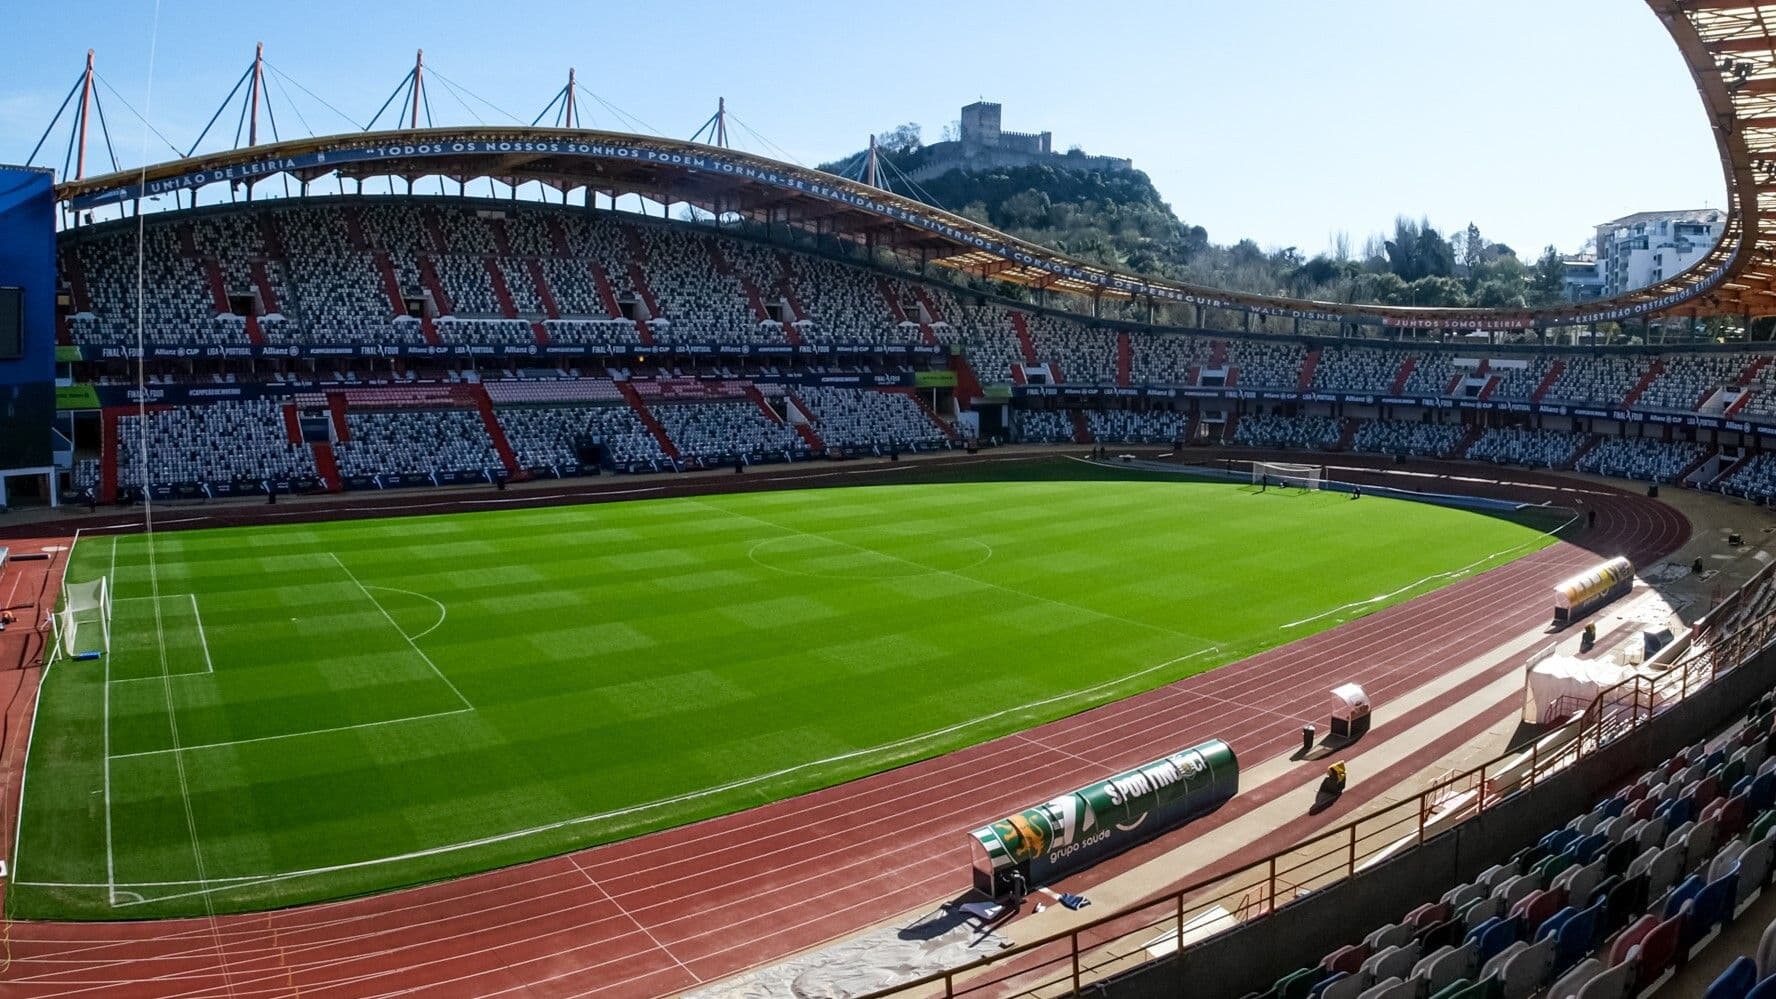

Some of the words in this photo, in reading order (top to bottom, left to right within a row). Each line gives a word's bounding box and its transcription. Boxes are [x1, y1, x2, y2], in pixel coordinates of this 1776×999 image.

[151, 173, 206, 193] UNIÃO
[214, 169, 234, 180] DE
[241, 158, 296, 175] LEIRIA
[452, 142, 475, 151] OS
[486, 142, 559, 152] NOSSOS
[567, 143, 639, 158] SONHOS
[648, 152, 705, 168] PODEM
[714, 161, 803, 189] TORNAR-SE
[811, 185, 894, 215] REALIDADE
[900, 212, 917, 223] SE
[922, 220, 992, 250] TIVERMOS
[1014, 252, 1083, 278] CORAGEM
[1090, 274, 1107, 284] DE
[1251, 306, 1286, 317] WALT
[1292, 310, 1343, 322] DISNEY
[1394, 319, 1439, 328] JUNTOS
[1444, 320, 1483, 329] SOMOS
[1487, 320, 1523, 329] LEIRIA
[262, 347, 288, 355] Allianz
[504, 345, 527, 353] Allianz
[1050, 842, 1080, 864] grupo
